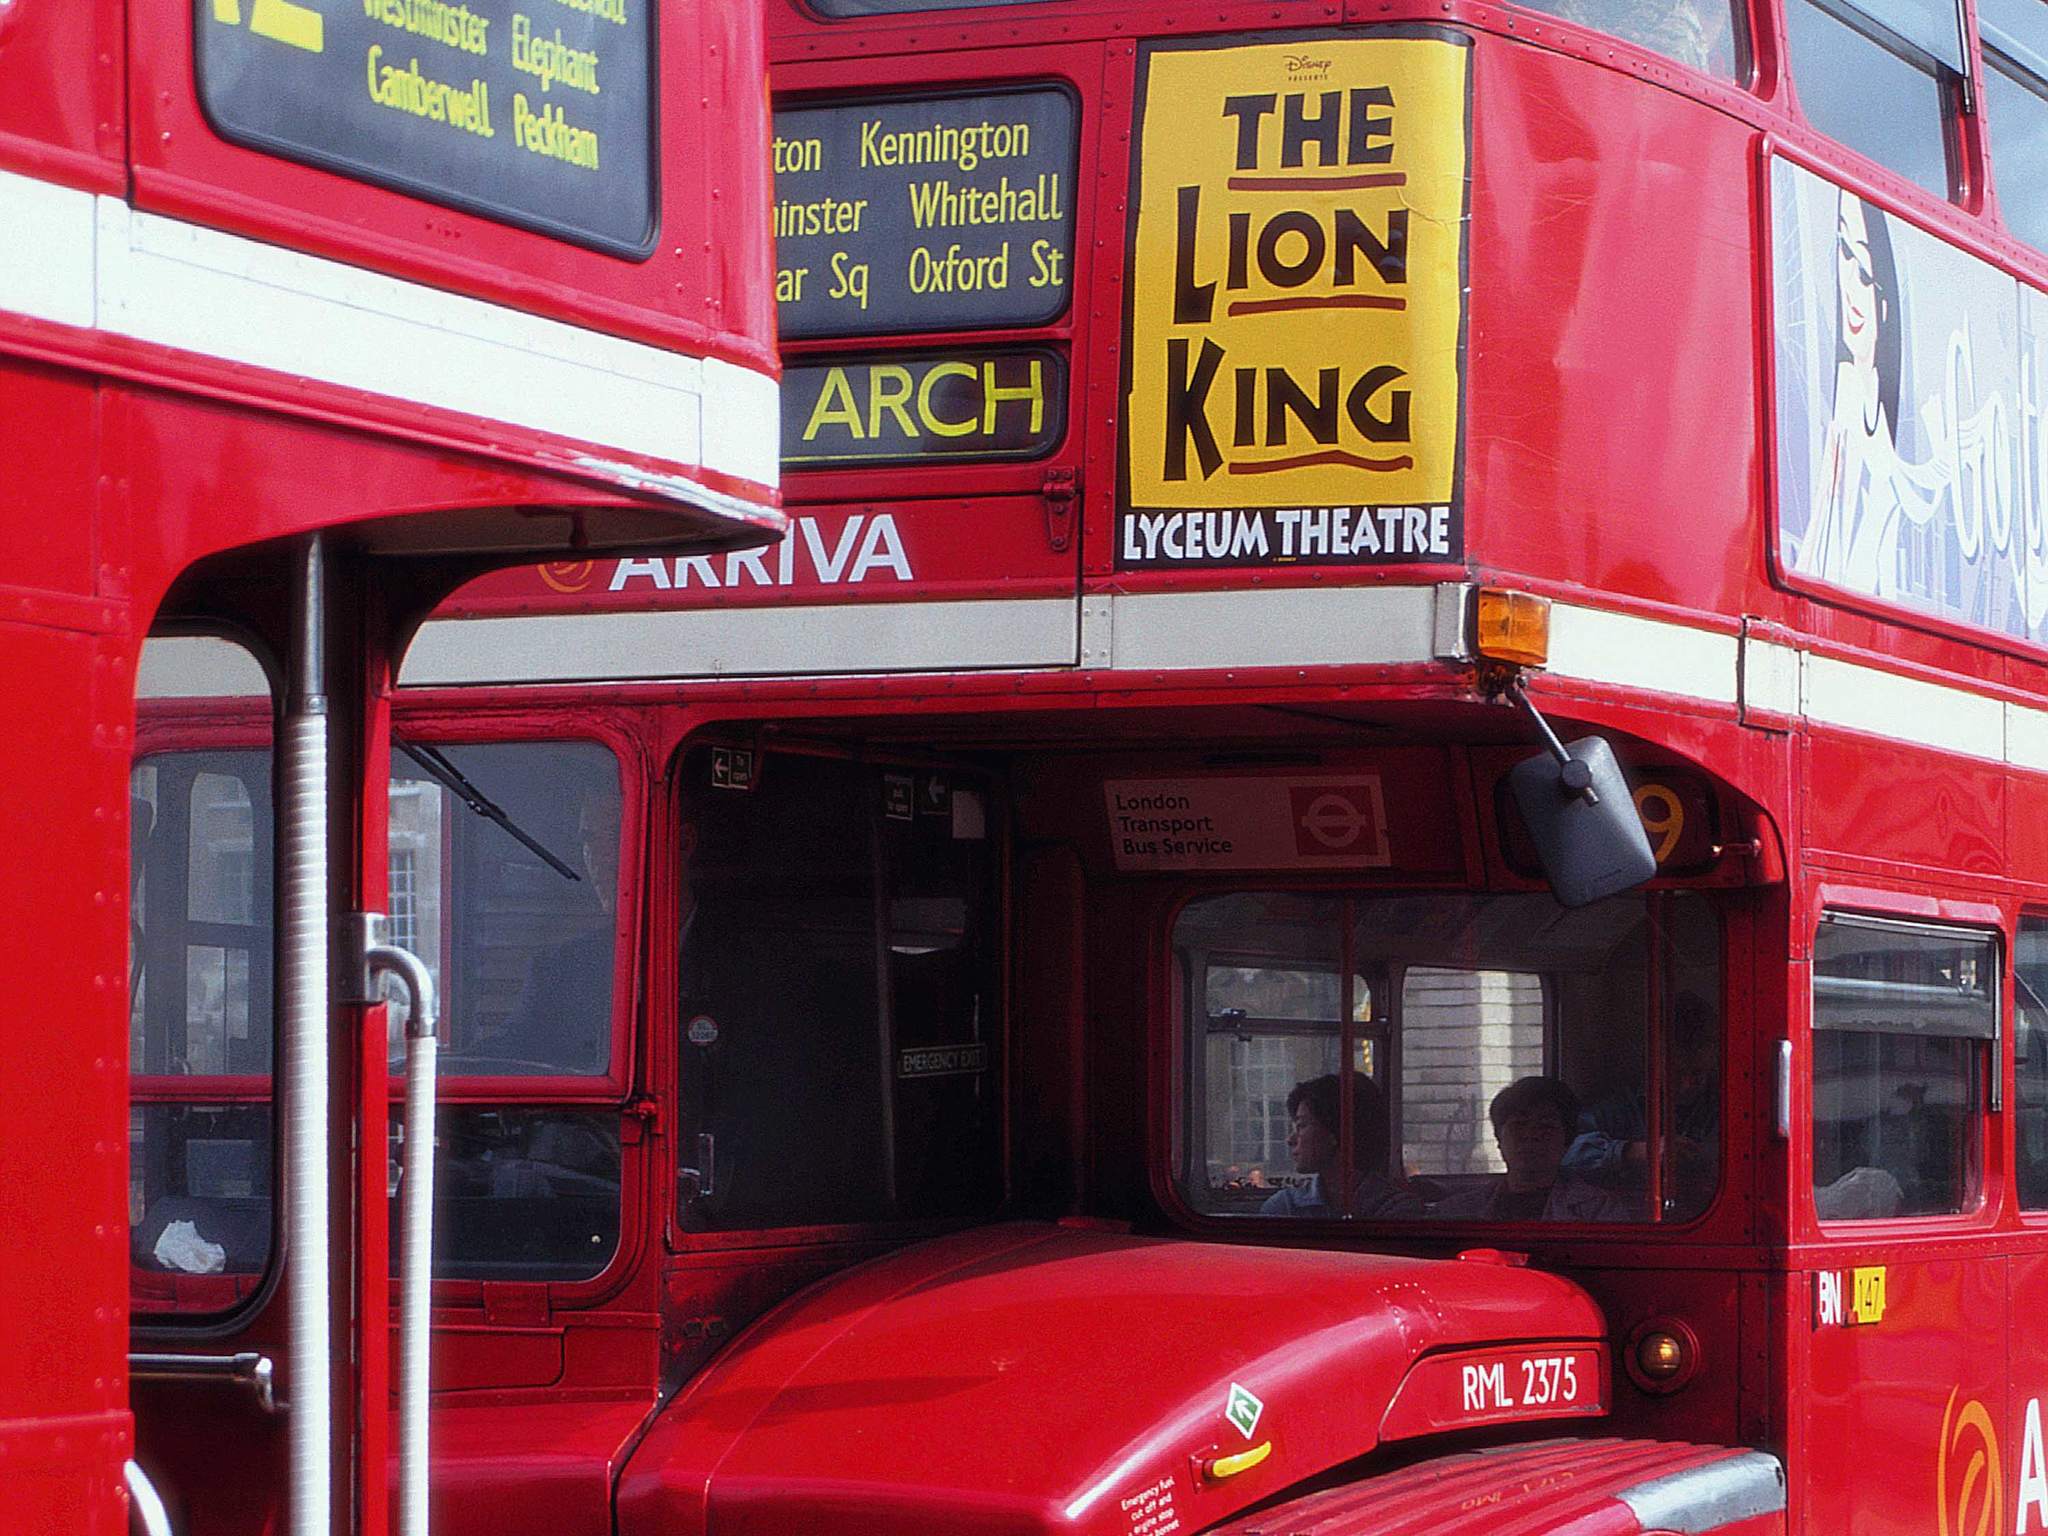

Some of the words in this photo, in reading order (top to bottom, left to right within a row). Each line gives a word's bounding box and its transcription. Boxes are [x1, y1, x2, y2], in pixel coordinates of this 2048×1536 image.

[511, 13, 600, 95] Elephant
[1282, 54, 1332, 73] Disney
[367, 44, 494, 138] Camberwell
[513, 93, 600, 171] Peckham
[860, 119, 1030, 171] Kennington
[1222, 86, 1396, 171] THE
[773, 197, 868, 238] inster
[908, 173, 1064, 229] Whitehall
[829, 251, 869, 310] Sq
[908, 241, 1009, 294] Oxford
[1028, 239, 1065, 288] St
[1173, 185, 1410, 325] LION
[802, 359, 1044, 441] ARCH
[1163, 336, 1412, 482] KING
[1123, 510, 1270, 560] LYCEUM
[1275, 506, 1450, 557] THEATRE
[1115, 794, 1190, 811] London
[1119, 815, 1214, 836] Transport
[1123, 839, 1157, 855] Bus
[1163, 838, 1233, 854] Service
[1819, 1271, 1842, 1326] BN
[1462, 1362, 1514, 1411] RML
[1521, 1356, 1577, 1405] 2375
[1120, 1484, 1159, 1511] Emergency
